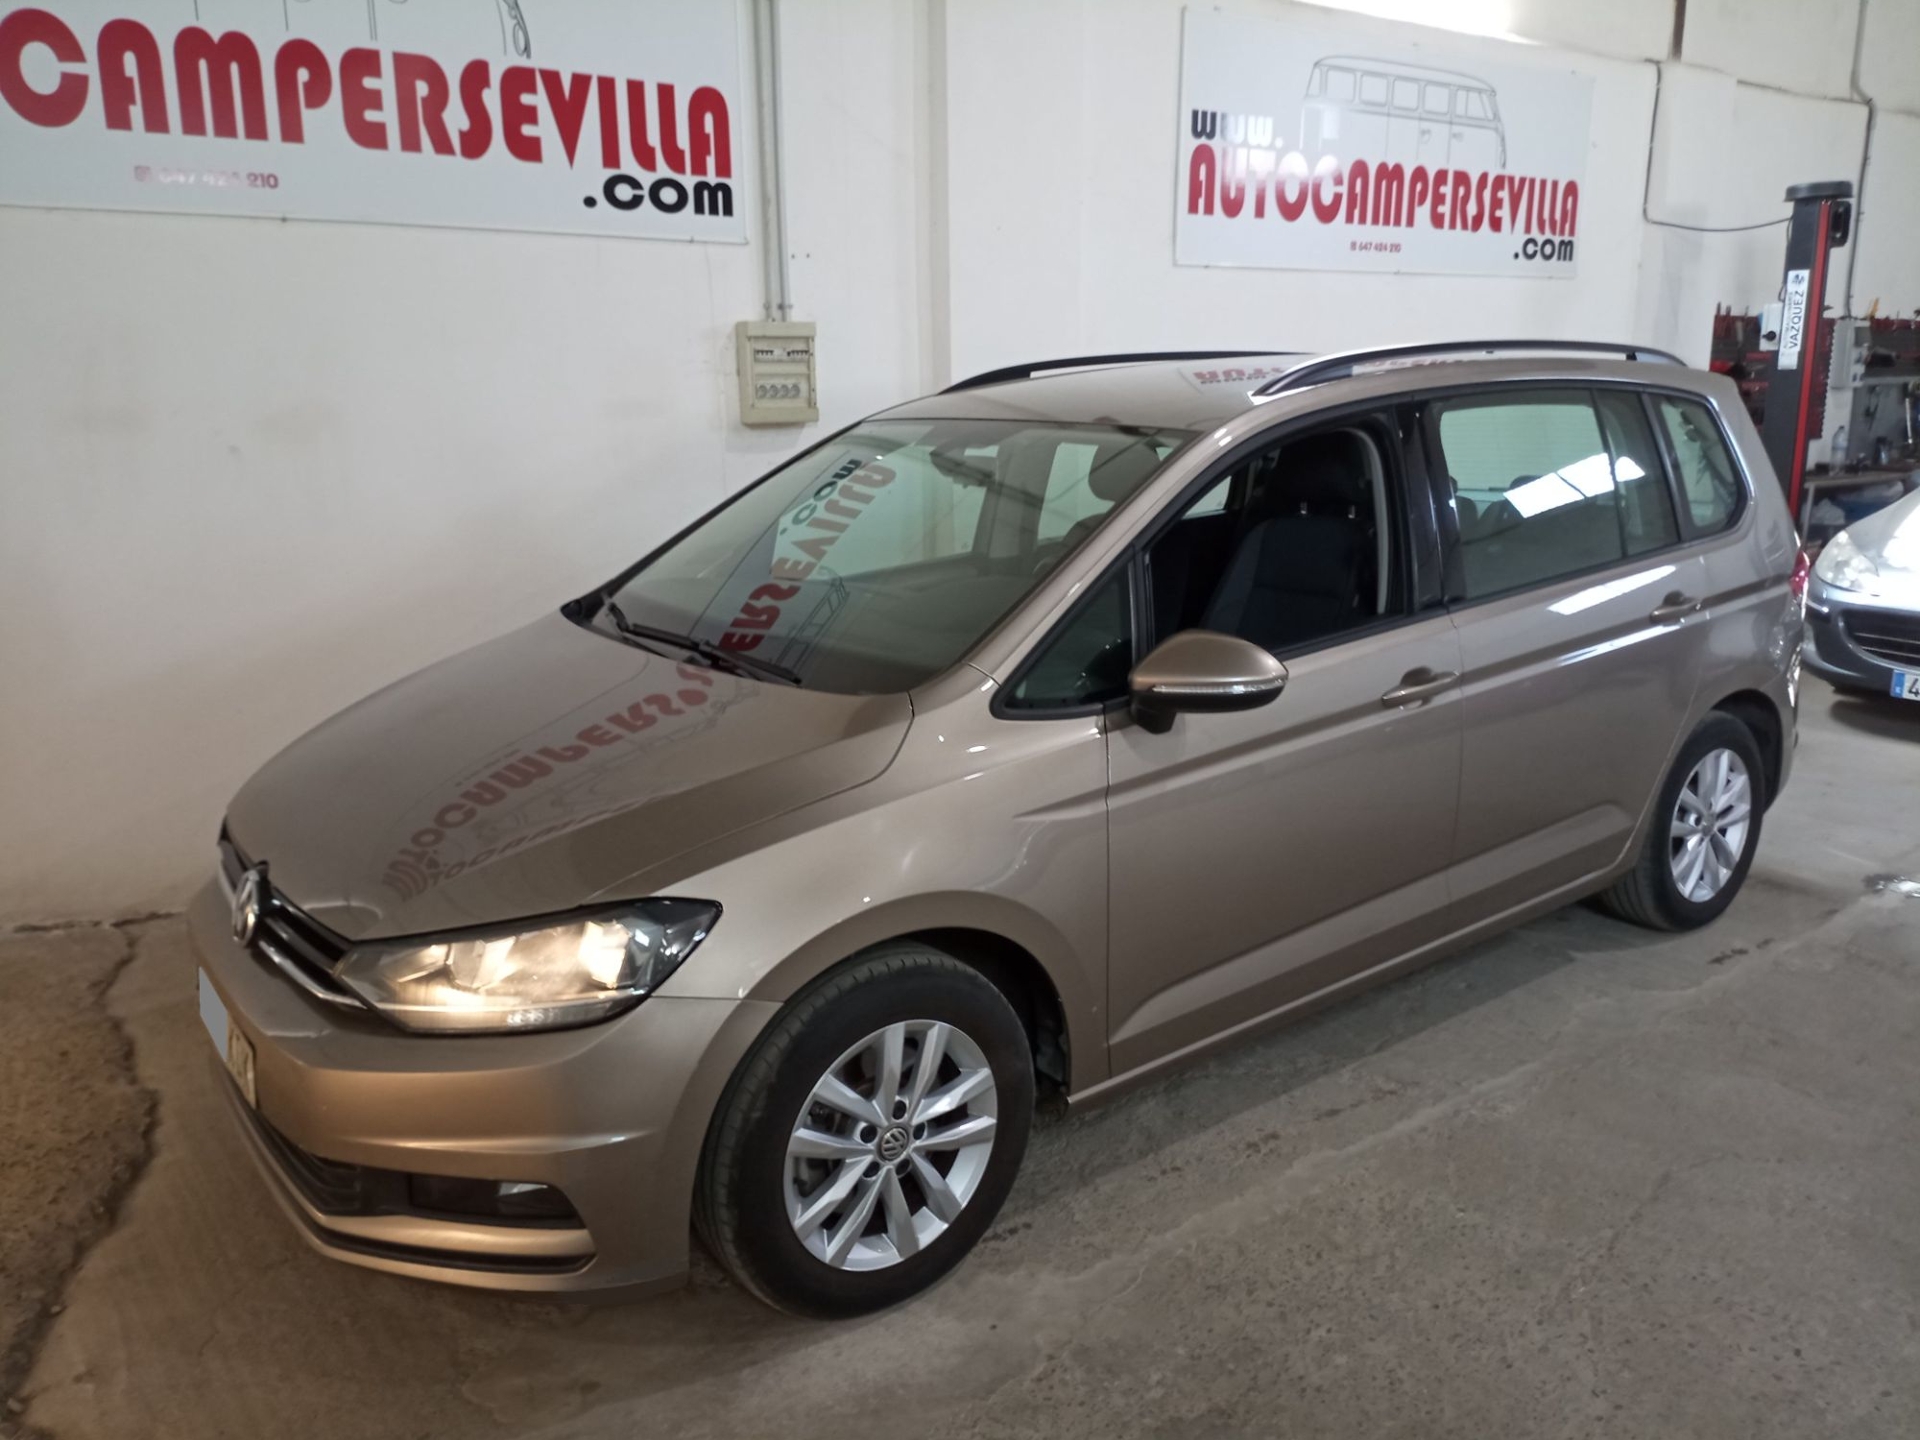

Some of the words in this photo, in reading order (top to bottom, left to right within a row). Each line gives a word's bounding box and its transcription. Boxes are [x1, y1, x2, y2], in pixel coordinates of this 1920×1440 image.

[0, 8, 733, 179] CAMPERSEVILLA
[247, 172, 279, 189] 210
[1187, 143, 1579, 238] AUTOCAMPERSEVILLA
[1788, 290, 1805, 349] VAZQUEZ
